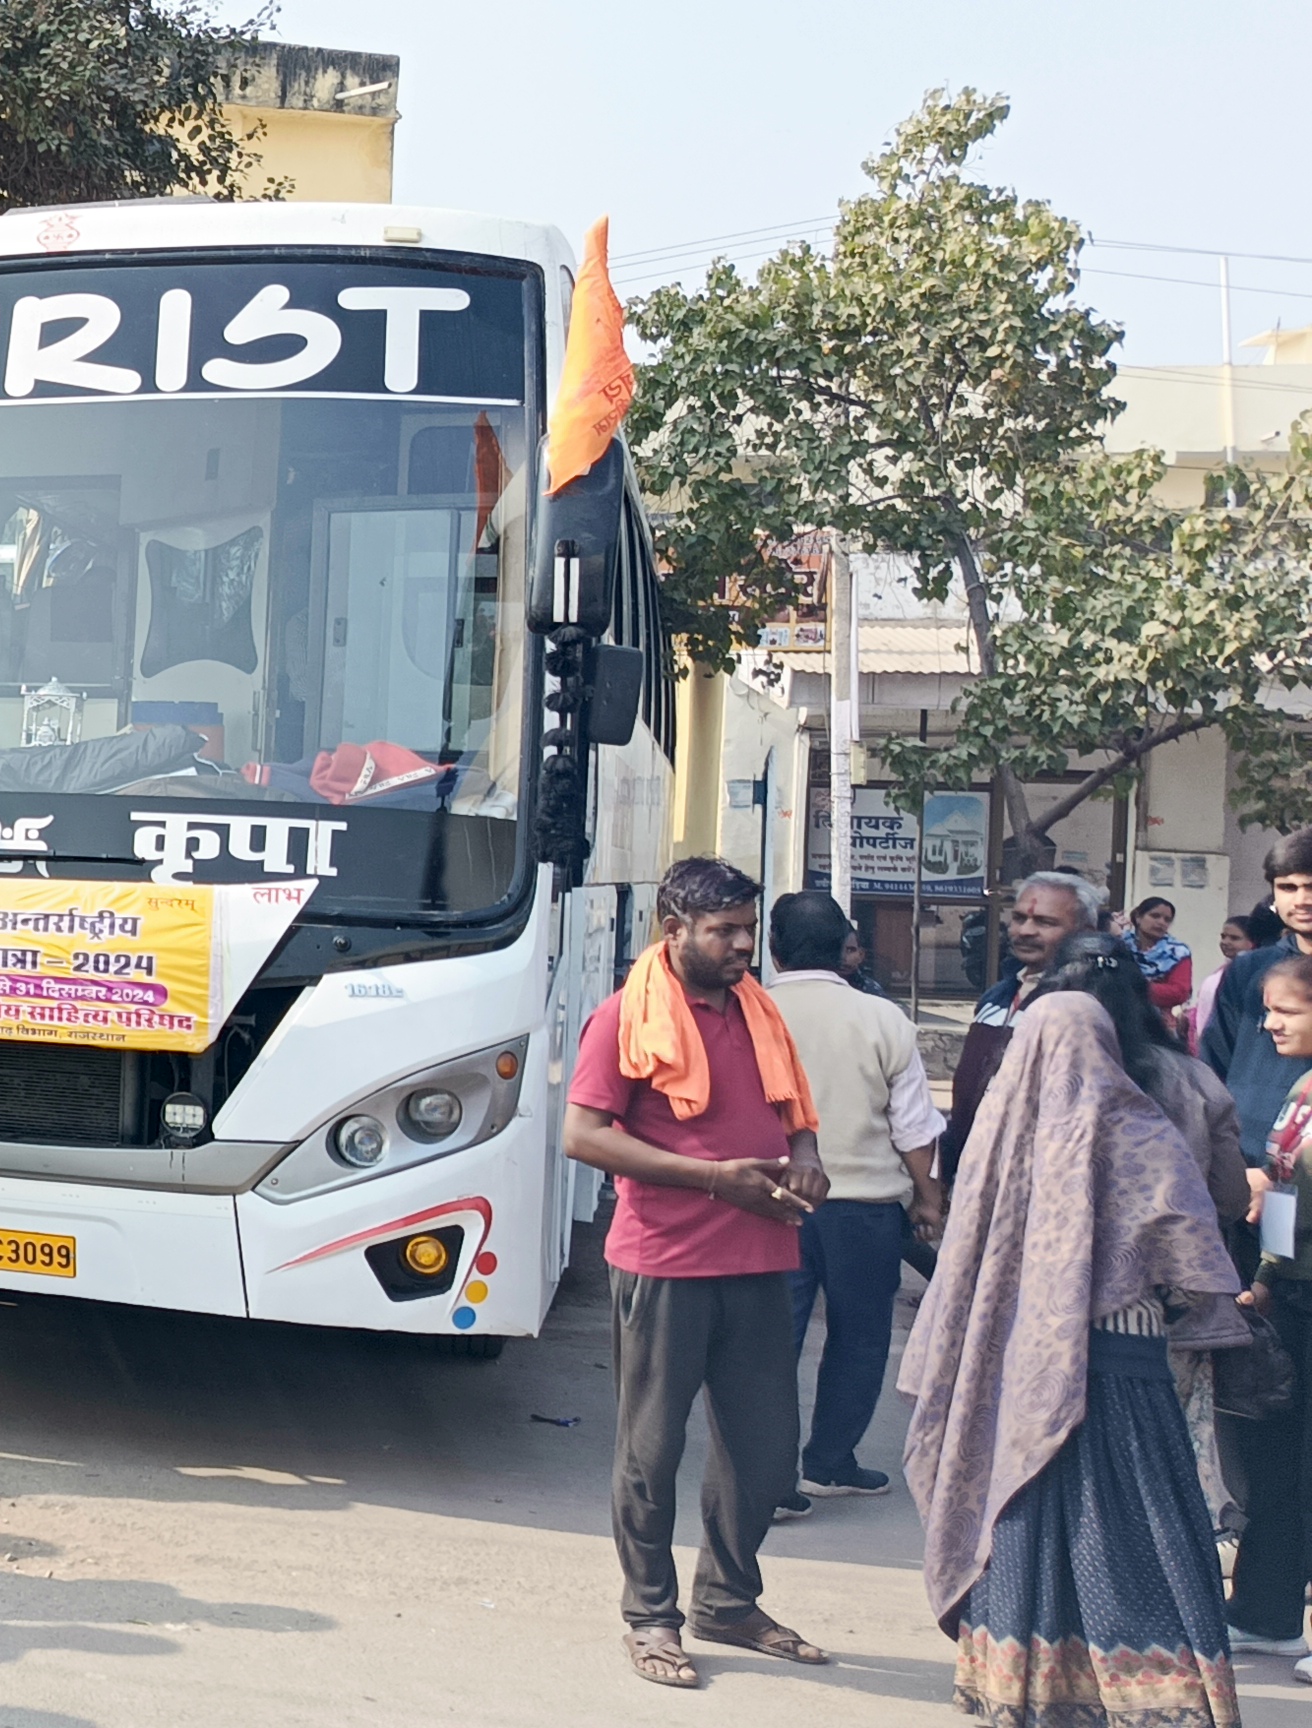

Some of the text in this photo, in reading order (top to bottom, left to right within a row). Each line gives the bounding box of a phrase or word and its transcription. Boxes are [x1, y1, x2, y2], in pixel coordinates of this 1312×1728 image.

[129, 811, 348, 884] कृपा
[252, 886, 305, 905] लाभ
[72, 951, 155, 977] 2024
[16, 983, 35, 996] 31
[41, 981, 107, 1000] दिसम्बर
[112, 989, 155, 1004] 2024
[26, 1001, 110, 1027] साहित्य
[115, 1008, 196, 1032] परिषद
[66, 1029, 126, 1043] राजस्थान
